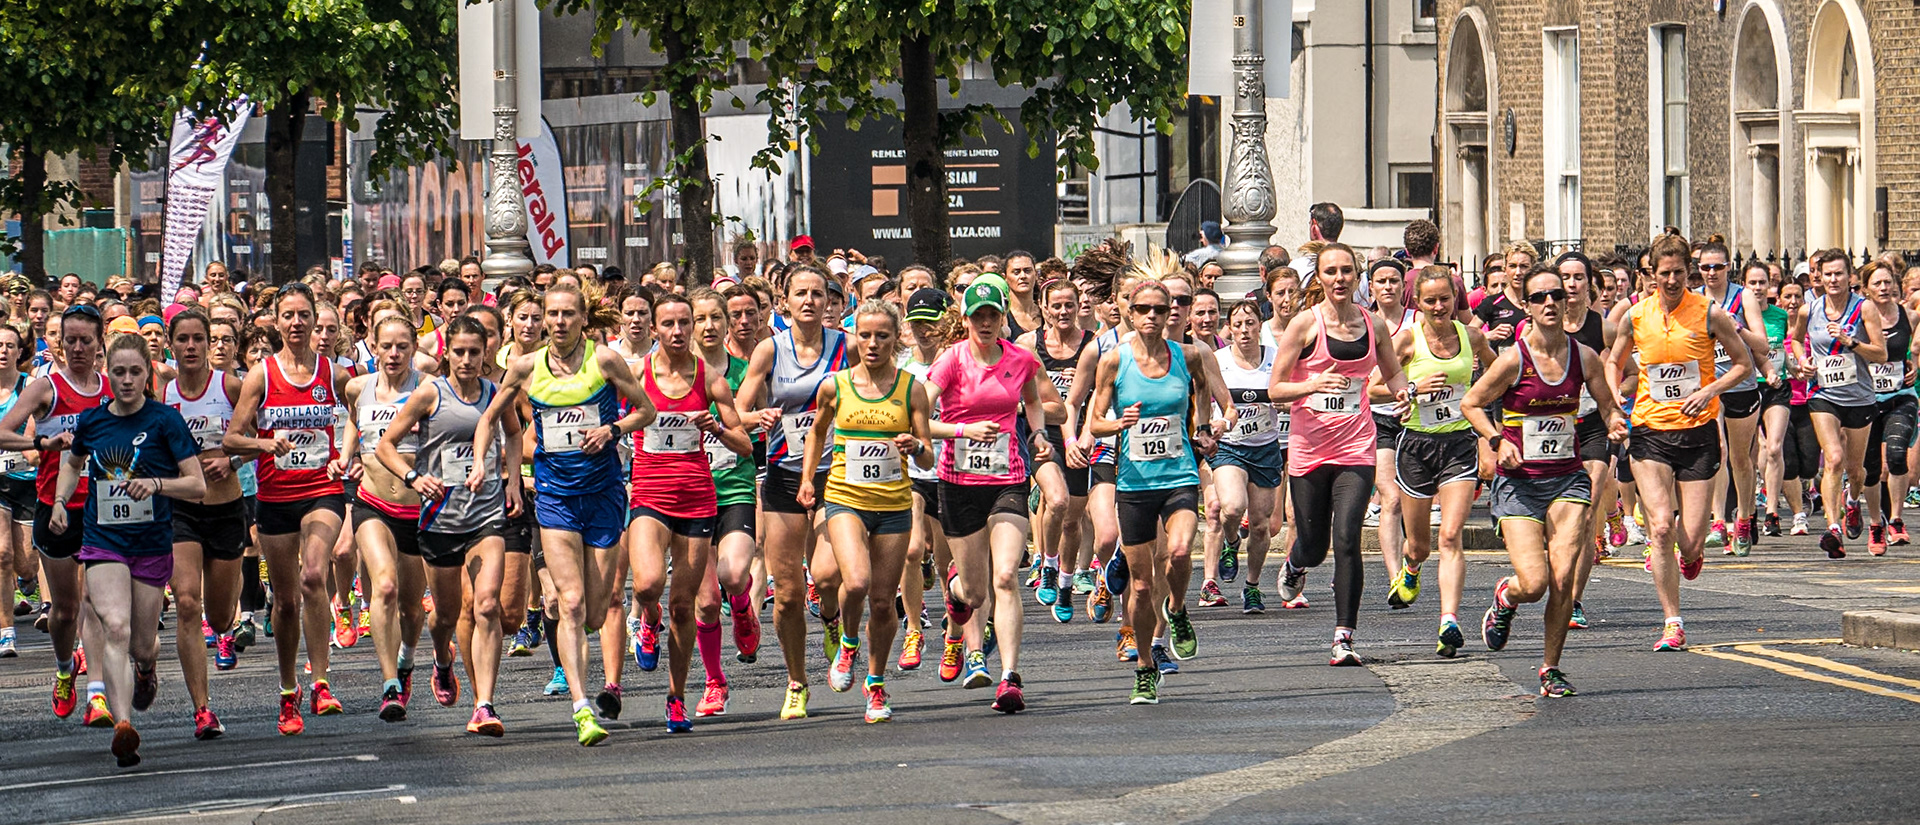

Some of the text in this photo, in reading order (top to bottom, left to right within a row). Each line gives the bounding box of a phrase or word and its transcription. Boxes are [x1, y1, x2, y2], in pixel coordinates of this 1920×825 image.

[530, 152, 538, 167] THE
[943, 149, 968, 157] MENTS
[969, 149, 1000, 157] LIMITED
[947, 171, 977, 184] SIAN
[948, 195, 964, 208] ZA
[1825, 357, 1843, 368] Vhi
[1659, 367, 1684, 379] Vhi
[1874, 364, 1893, 375] Vhi
[1824, 371, 1845, 383] 1144
[1876, 378, 1893, 389] 581
[1430, 389, 1451, 403] Vhi
[1665, 384, 1681, 398] 65
[1324, 397, 1344, 410] 108
[371, 409, 395, 421] Vhi
[555, 411, 583, 424] Vhi
[1435, 406, 1451, 420] 64
[658, 415, 687, 428] Vhi
[795, 416, 814, 428] Vh
[1140, 421, 1167, 434] Vhi
[1240, 421, 1258, 435] 104
[1537, 420, 1563, 432] Vhi
[196, 436, 205, 449] 2
[288, 431, 314, 445] Vhi
[565, 431, 572, 445] 1
[664, 434, 674, 448] 4
[456, 446, 474, 459] Vh
[858, 445, 888, 457] Vhi
[1142, 440, 1166, 455] 129
[1541, 439, 1558, 454] 62
[3, 458, 16, 471] 76
[291, 451, 307, 465] 52
[968, 455, 991, 469] 134
[863, 464, 880, 479] 83
[109, 484, 127, 497] Vh
[113, 504, 130, 519] 89
